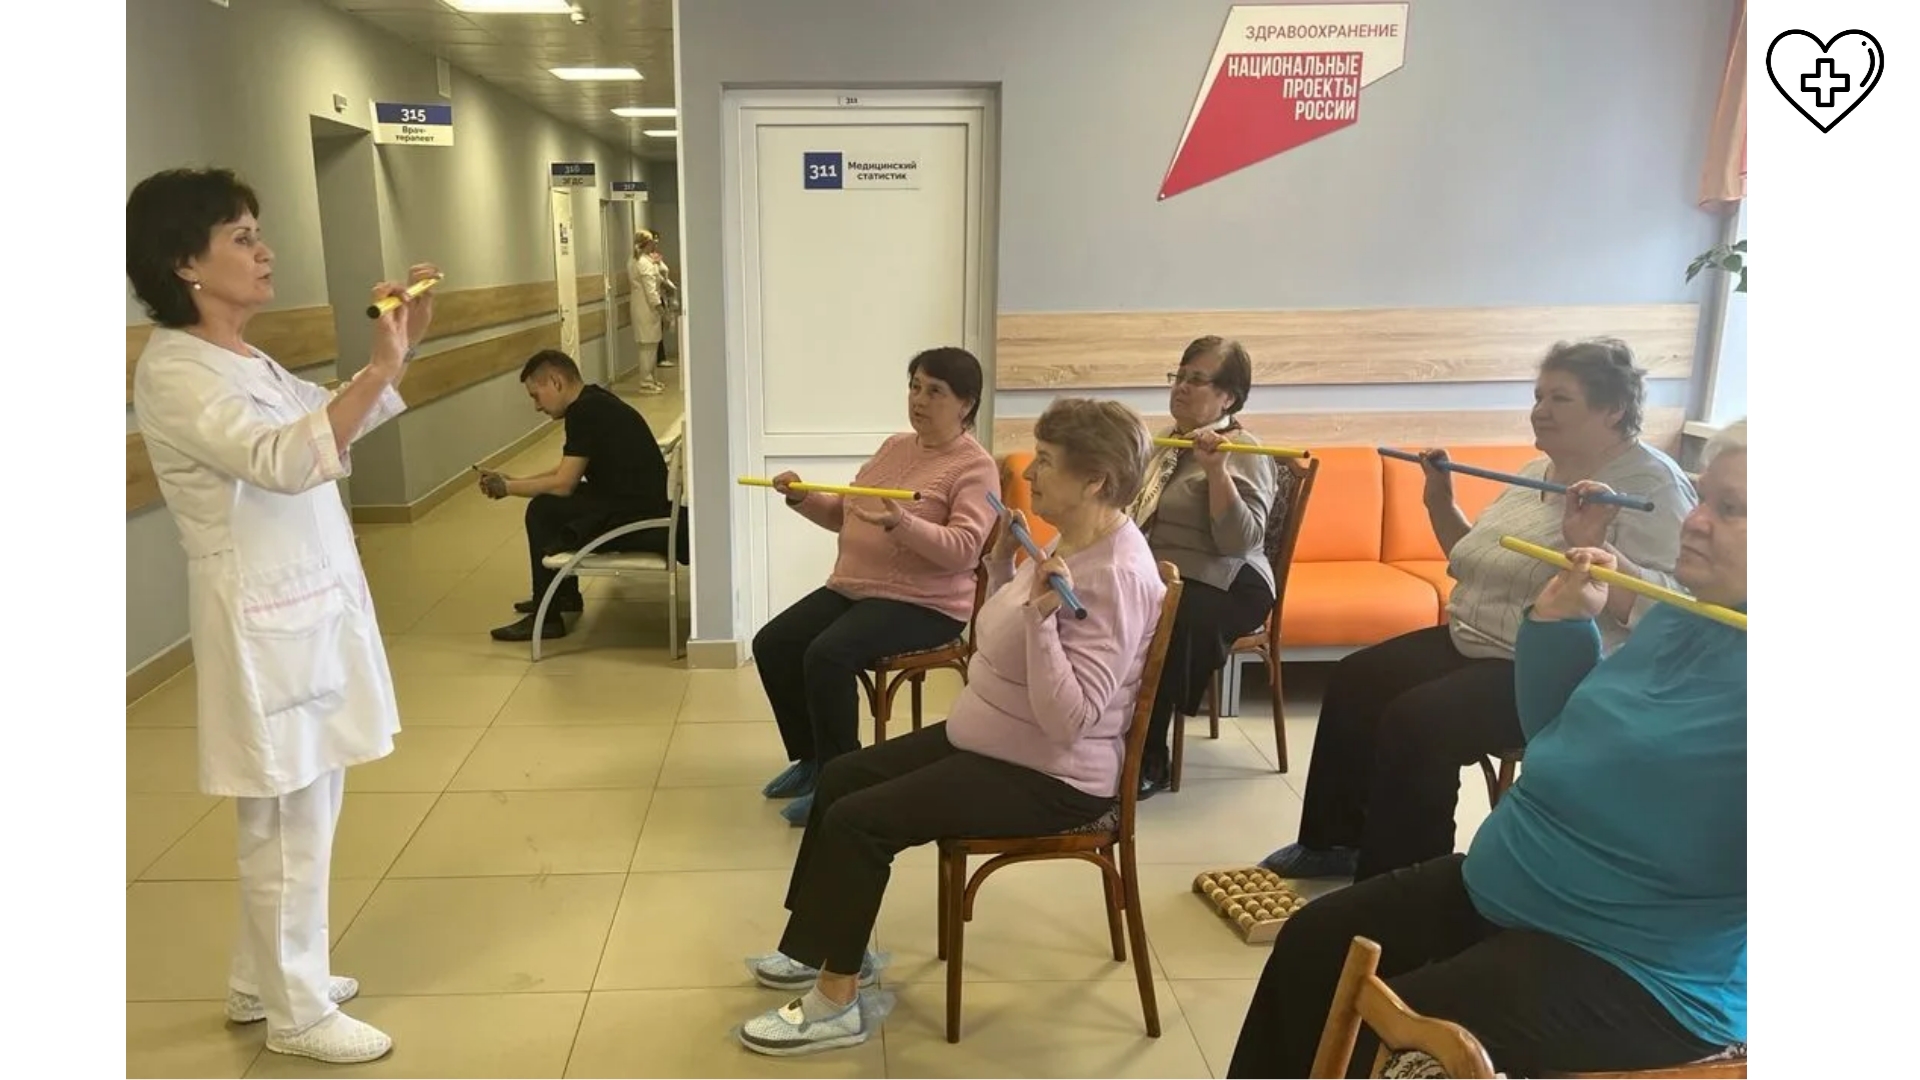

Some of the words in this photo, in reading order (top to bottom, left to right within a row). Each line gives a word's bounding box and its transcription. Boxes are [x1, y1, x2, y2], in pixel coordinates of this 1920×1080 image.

[1245, 24, 1399, 42] ЗДРАВООХРАНЕНИЕ
[1227, 54, 1360, 79] НАЦИОНАЛЬНЫЕ
[1282, 77, 1358, 99] ПРОЕКТЫ
[400, 108, 427, 122] 315
[1294, 100, 1356, 121] РОССИИ
[402, 126, 427, 135] Врач-
[395, 135, 435, 143] терапевт
[809, 164, 838, 180] 311
[847, 161, 917, 171] Медицинский
[856, 172, 908, 180] статистик
